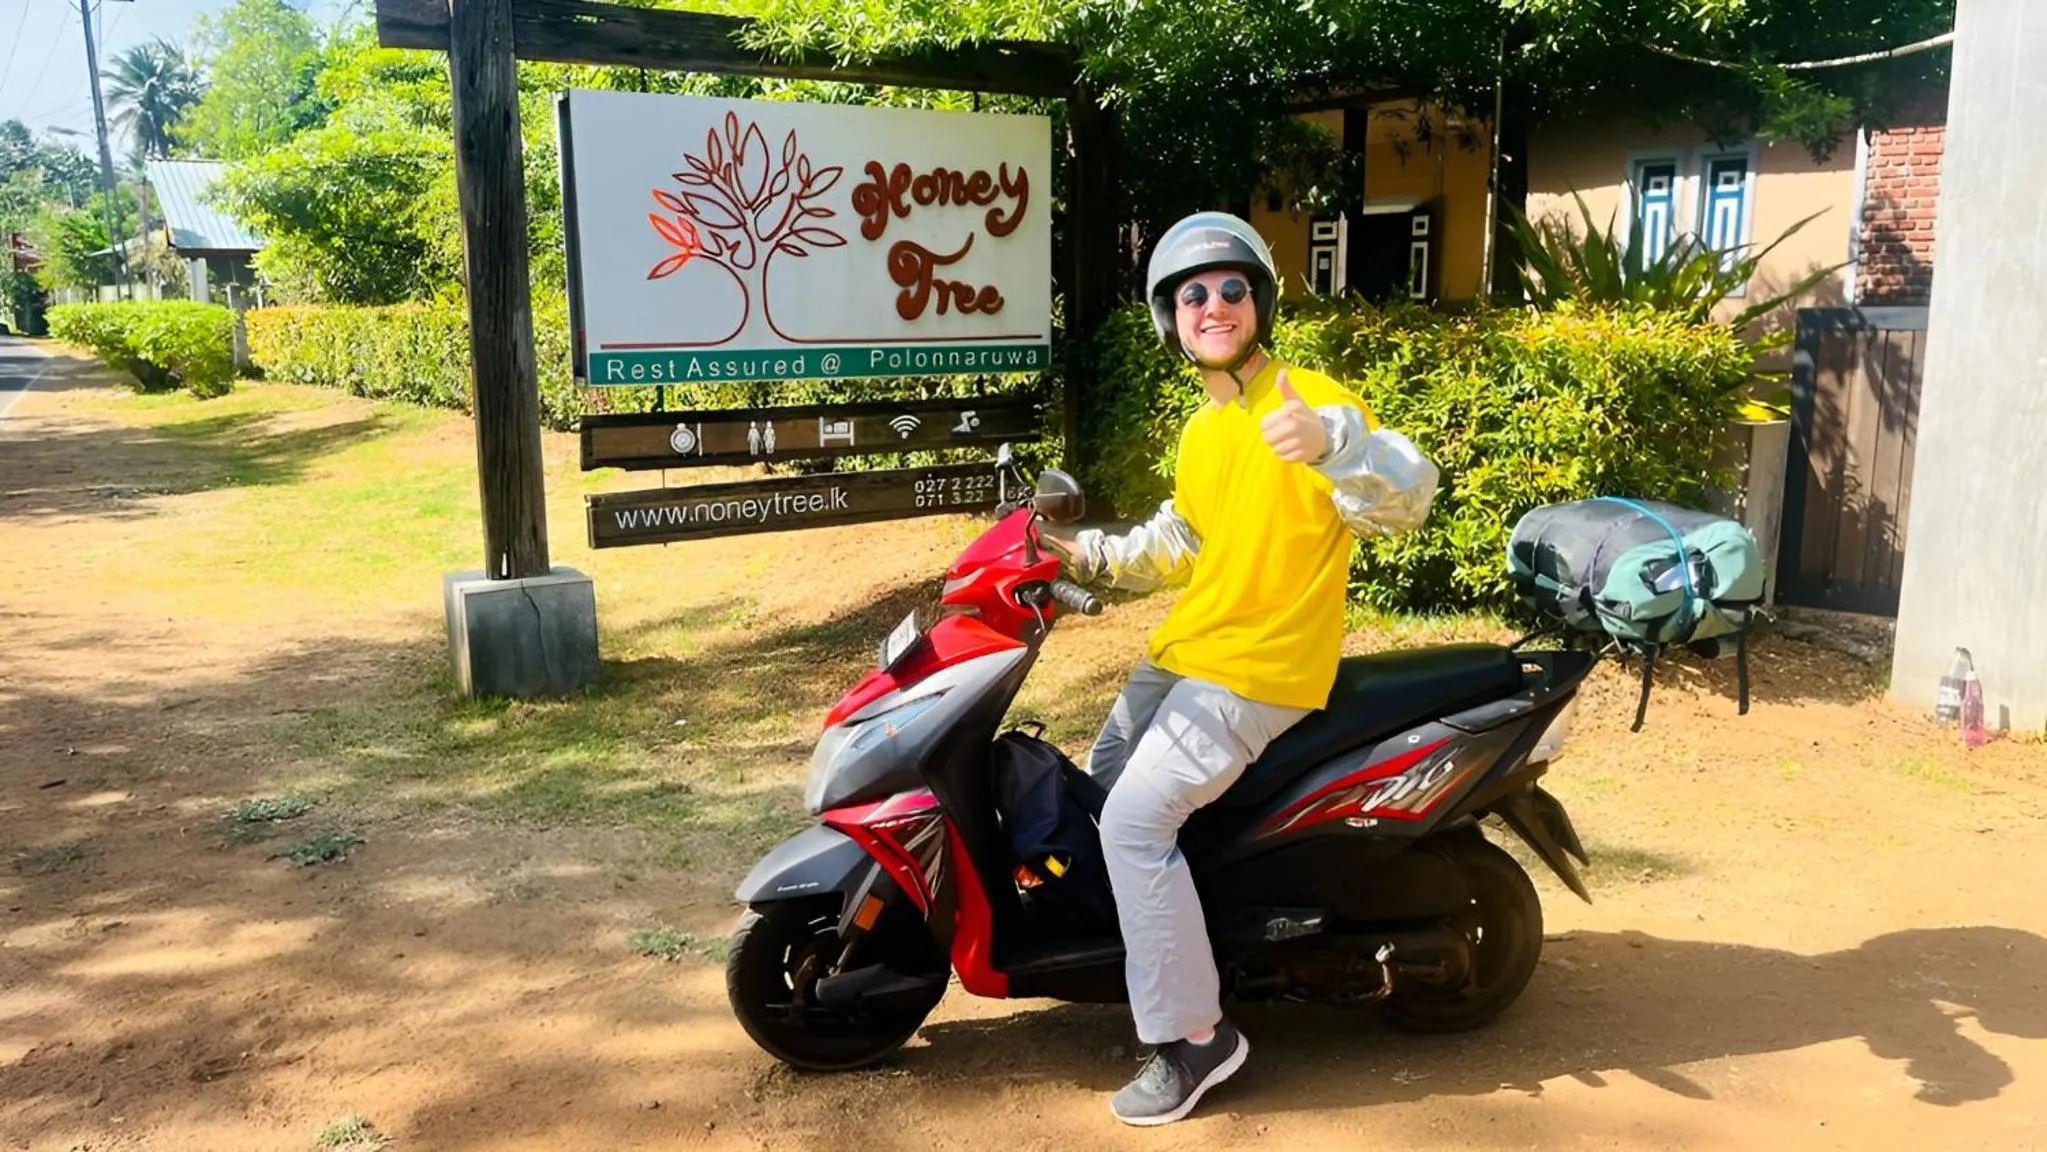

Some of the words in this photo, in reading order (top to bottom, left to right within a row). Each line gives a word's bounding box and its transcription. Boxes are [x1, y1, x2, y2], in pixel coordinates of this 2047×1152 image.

[851, 160, 1029, 241] Honey
[887, 232, 1005, 321] Tree
[606, 359, 676, 380] Rest
[687, 355, 805, 379] Assured
[820, 352, 842, 375] @
[870, 348, 1038, 369] Polonnaruwa
[914, 478, 946, 493] 027
[915, 494, 944, 507] 071
